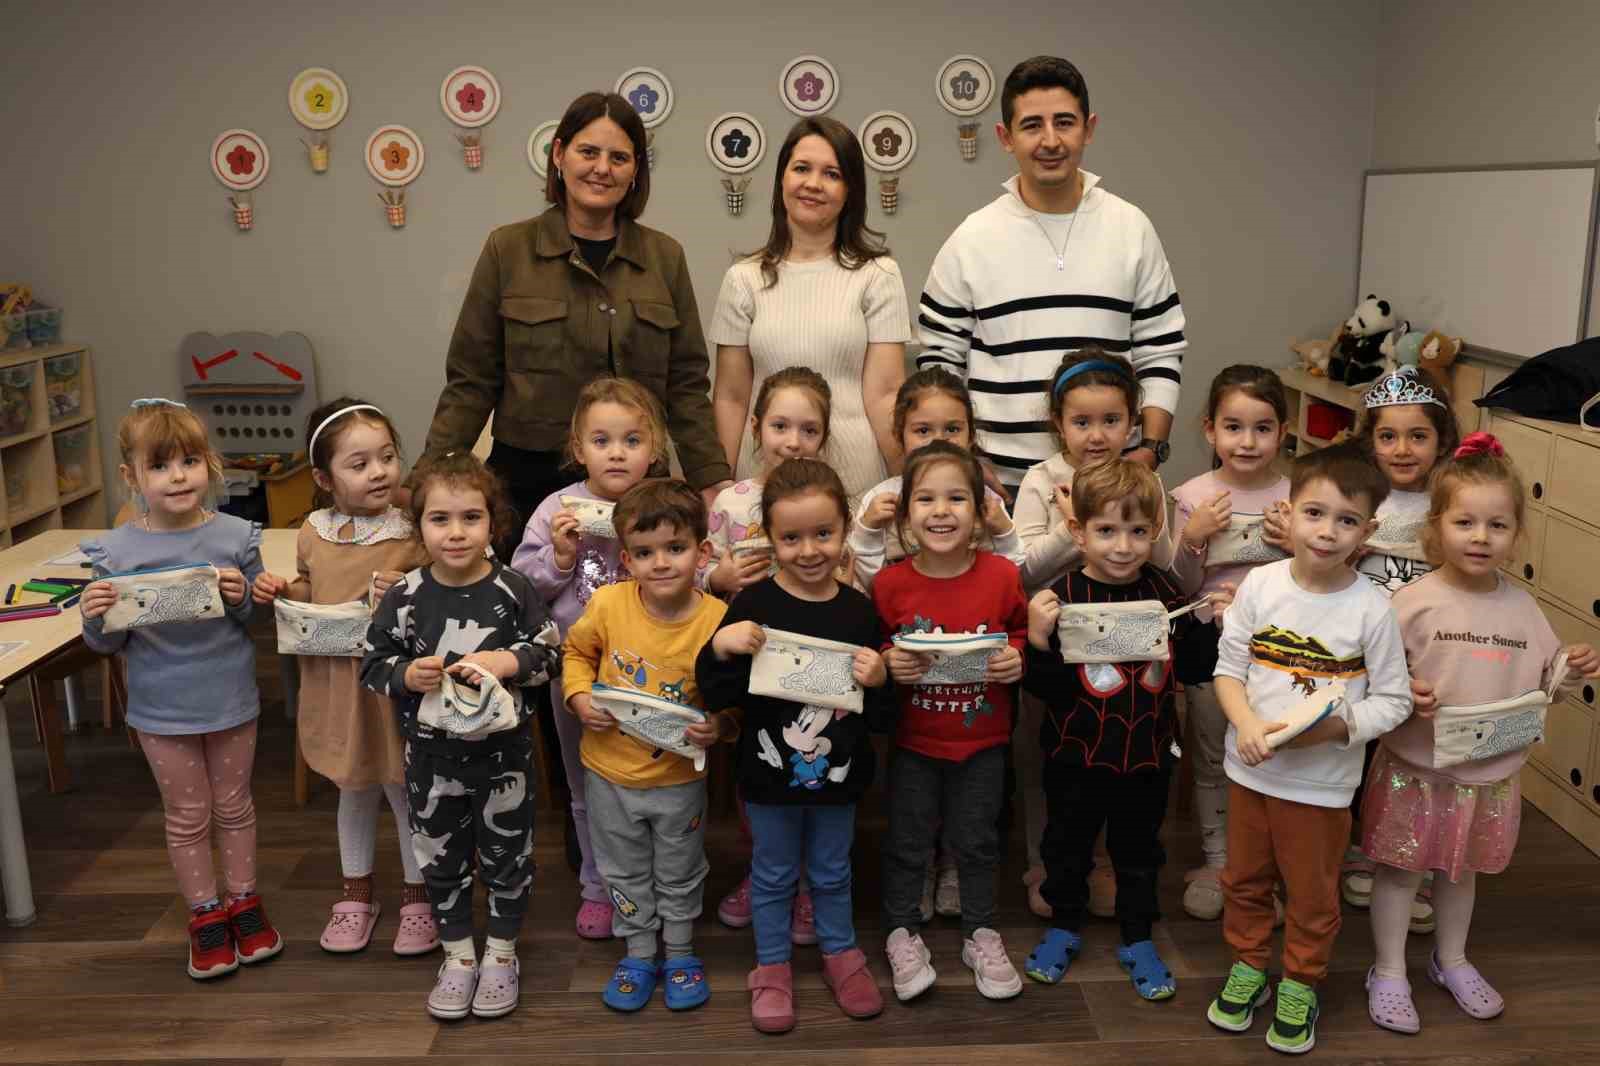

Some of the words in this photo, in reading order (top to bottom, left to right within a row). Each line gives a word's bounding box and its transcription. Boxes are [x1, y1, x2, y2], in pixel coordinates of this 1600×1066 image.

[804, 81, 814, 95] 8
[956, 80, 974, 95] 10
[314, 94, 325, 108] 2
[467, 92, 475, 106] 4
[639, 94, 649, 107] 6
[731, 138, 741, 152] 7
[882, 137, 892, 151] 9
[391, 150, 401, 164] 3
[1433, 629, 1490, 645] Another
[1491, 633, 1528, 650] Sunset
[912, 694, 985, 713] BETTER
